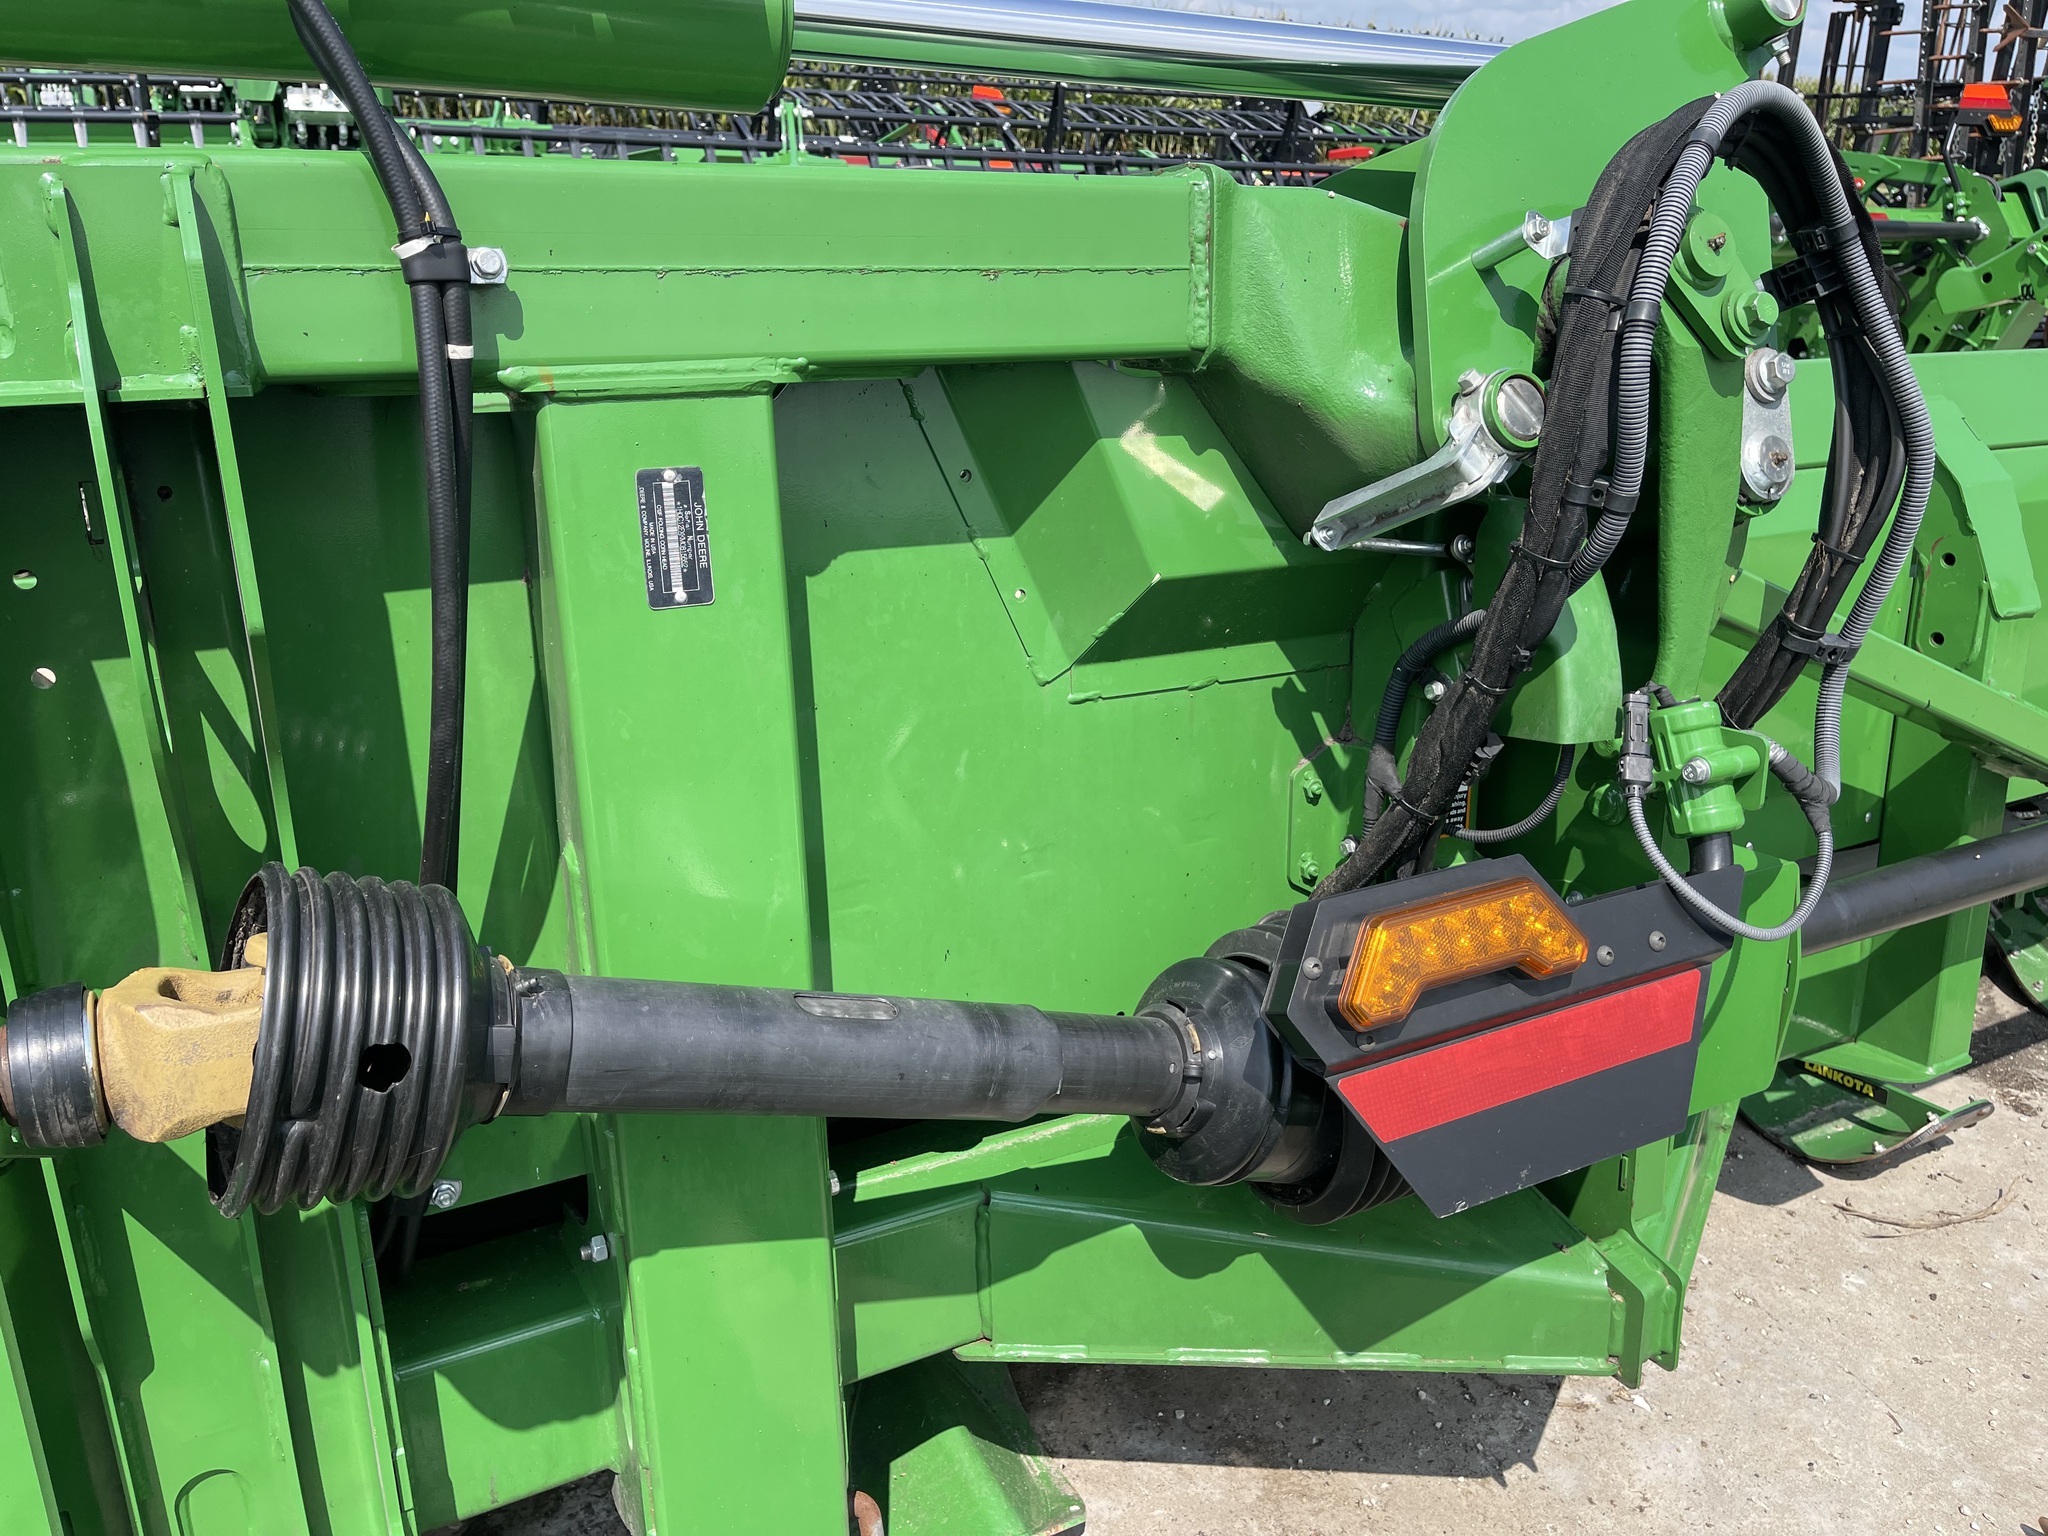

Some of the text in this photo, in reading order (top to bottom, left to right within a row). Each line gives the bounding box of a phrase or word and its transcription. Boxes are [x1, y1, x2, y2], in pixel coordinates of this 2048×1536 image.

[657, 517, 665, 539] FOLDING
[694, 502, 708, 568] JOHN DEERE
[1804, 1062, 1874, 1097] LANKOTA
